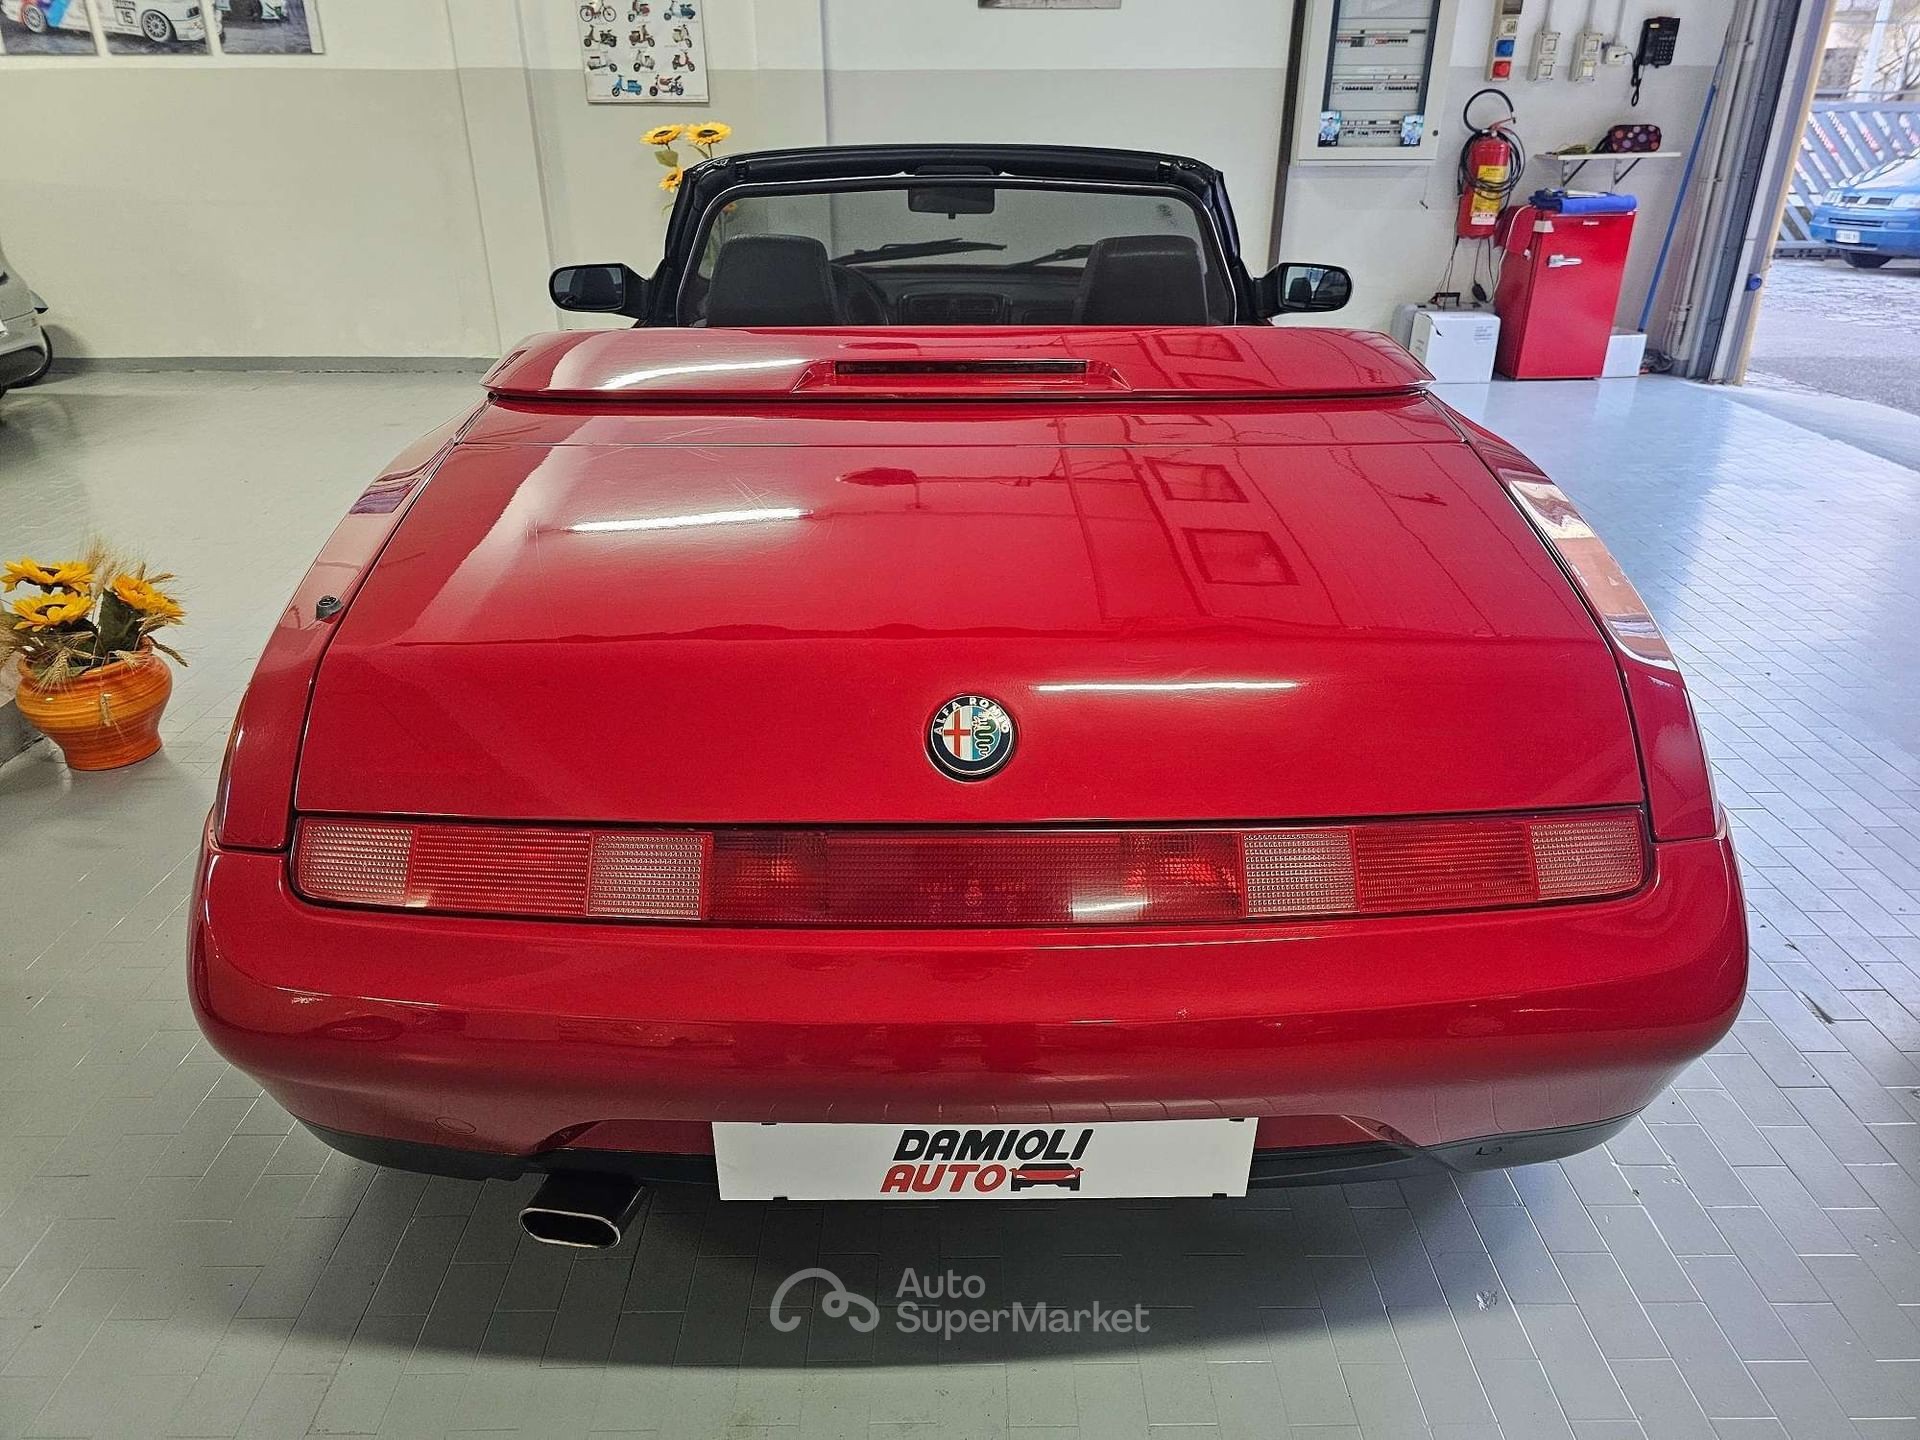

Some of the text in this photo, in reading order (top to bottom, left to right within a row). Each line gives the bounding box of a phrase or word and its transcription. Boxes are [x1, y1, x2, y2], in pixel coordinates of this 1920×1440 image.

[933, 697, 1010, 736] ALFA ROMEO
[892, 1129, 1094, 1161] DAMIOLI
[880, 1163, 1006, 1193] AUTO
